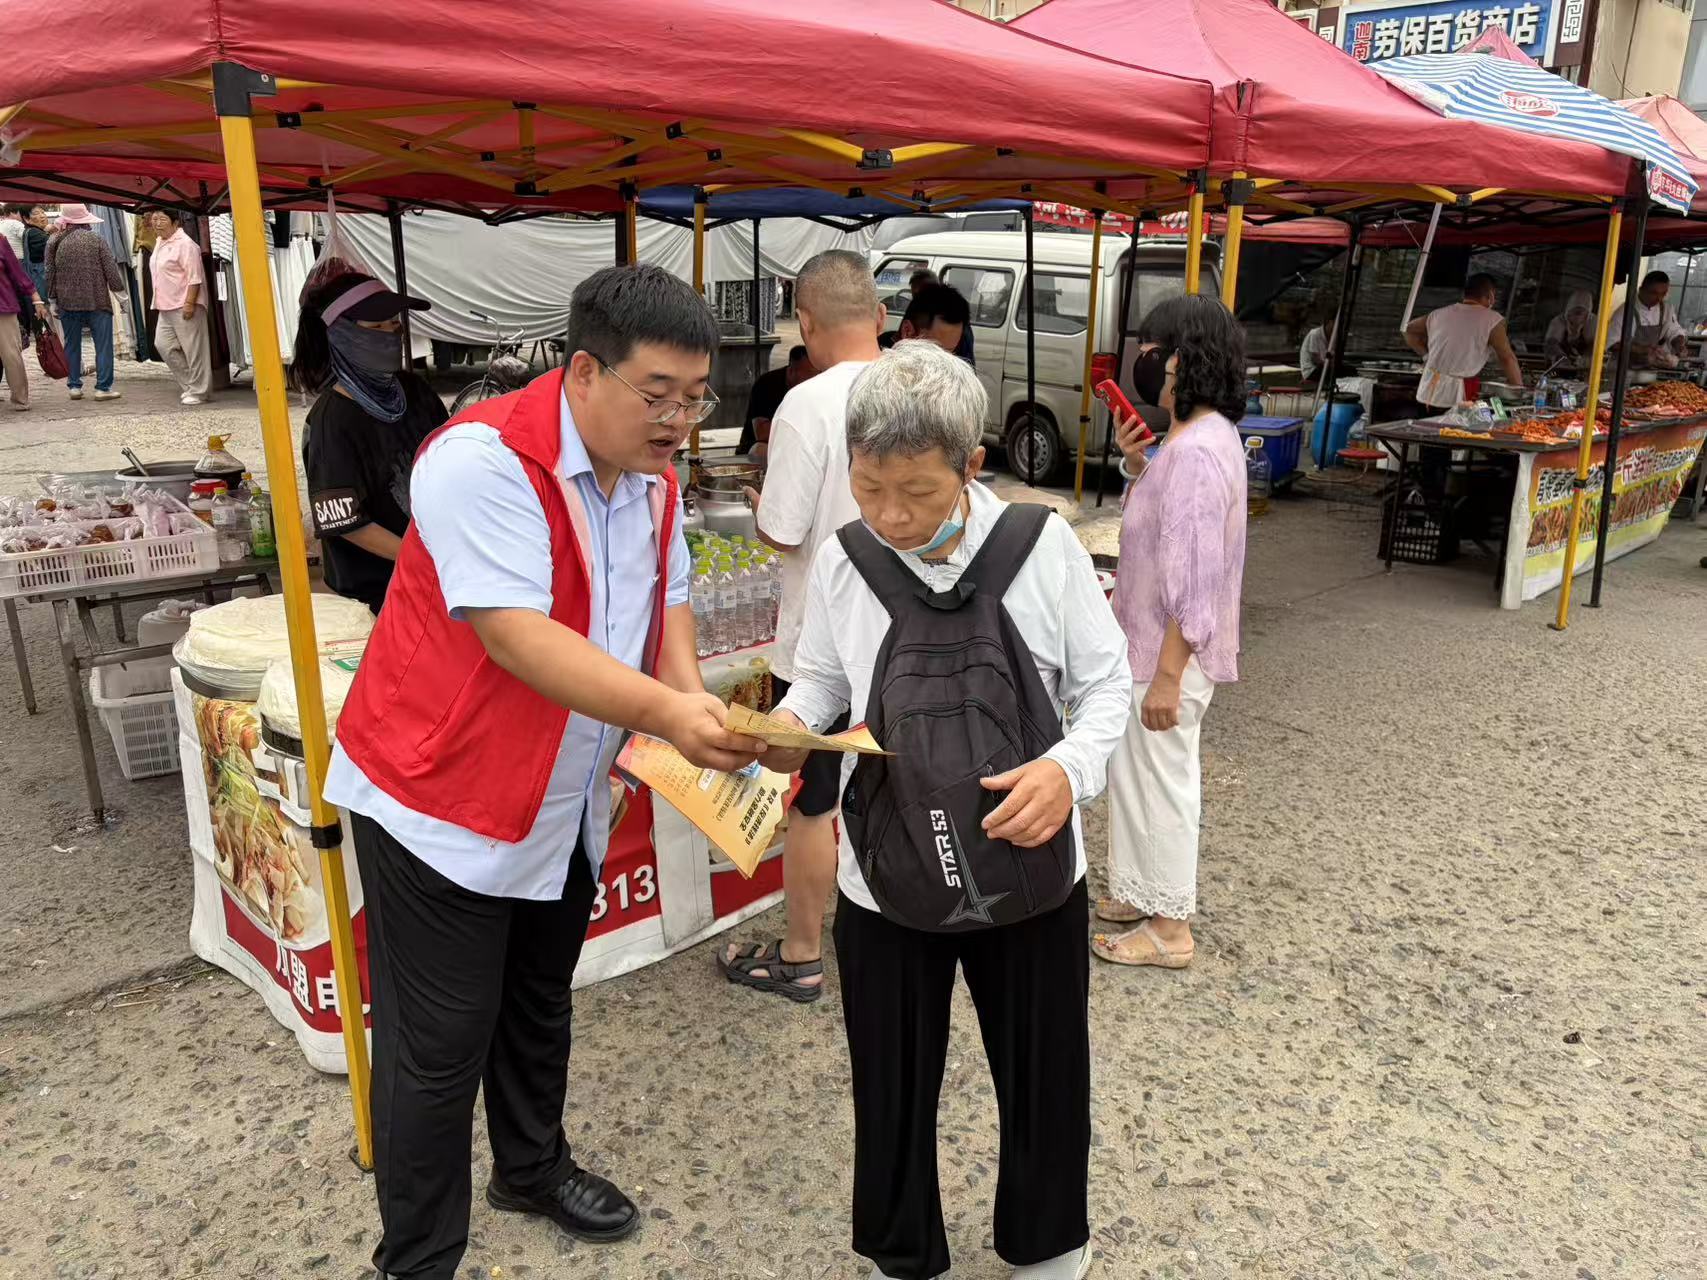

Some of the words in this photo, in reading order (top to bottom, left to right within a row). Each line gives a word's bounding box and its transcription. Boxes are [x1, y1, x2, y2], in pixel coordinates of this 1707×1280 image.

[1373, 2, 1540, 58] 劳保百货商店
[315, 497, 354, 523] SAINT
[738, 785, 767, 832] 助力金融安全
[929, 809, 948, 831] 53
[935, 834, 962, 888] STAR
